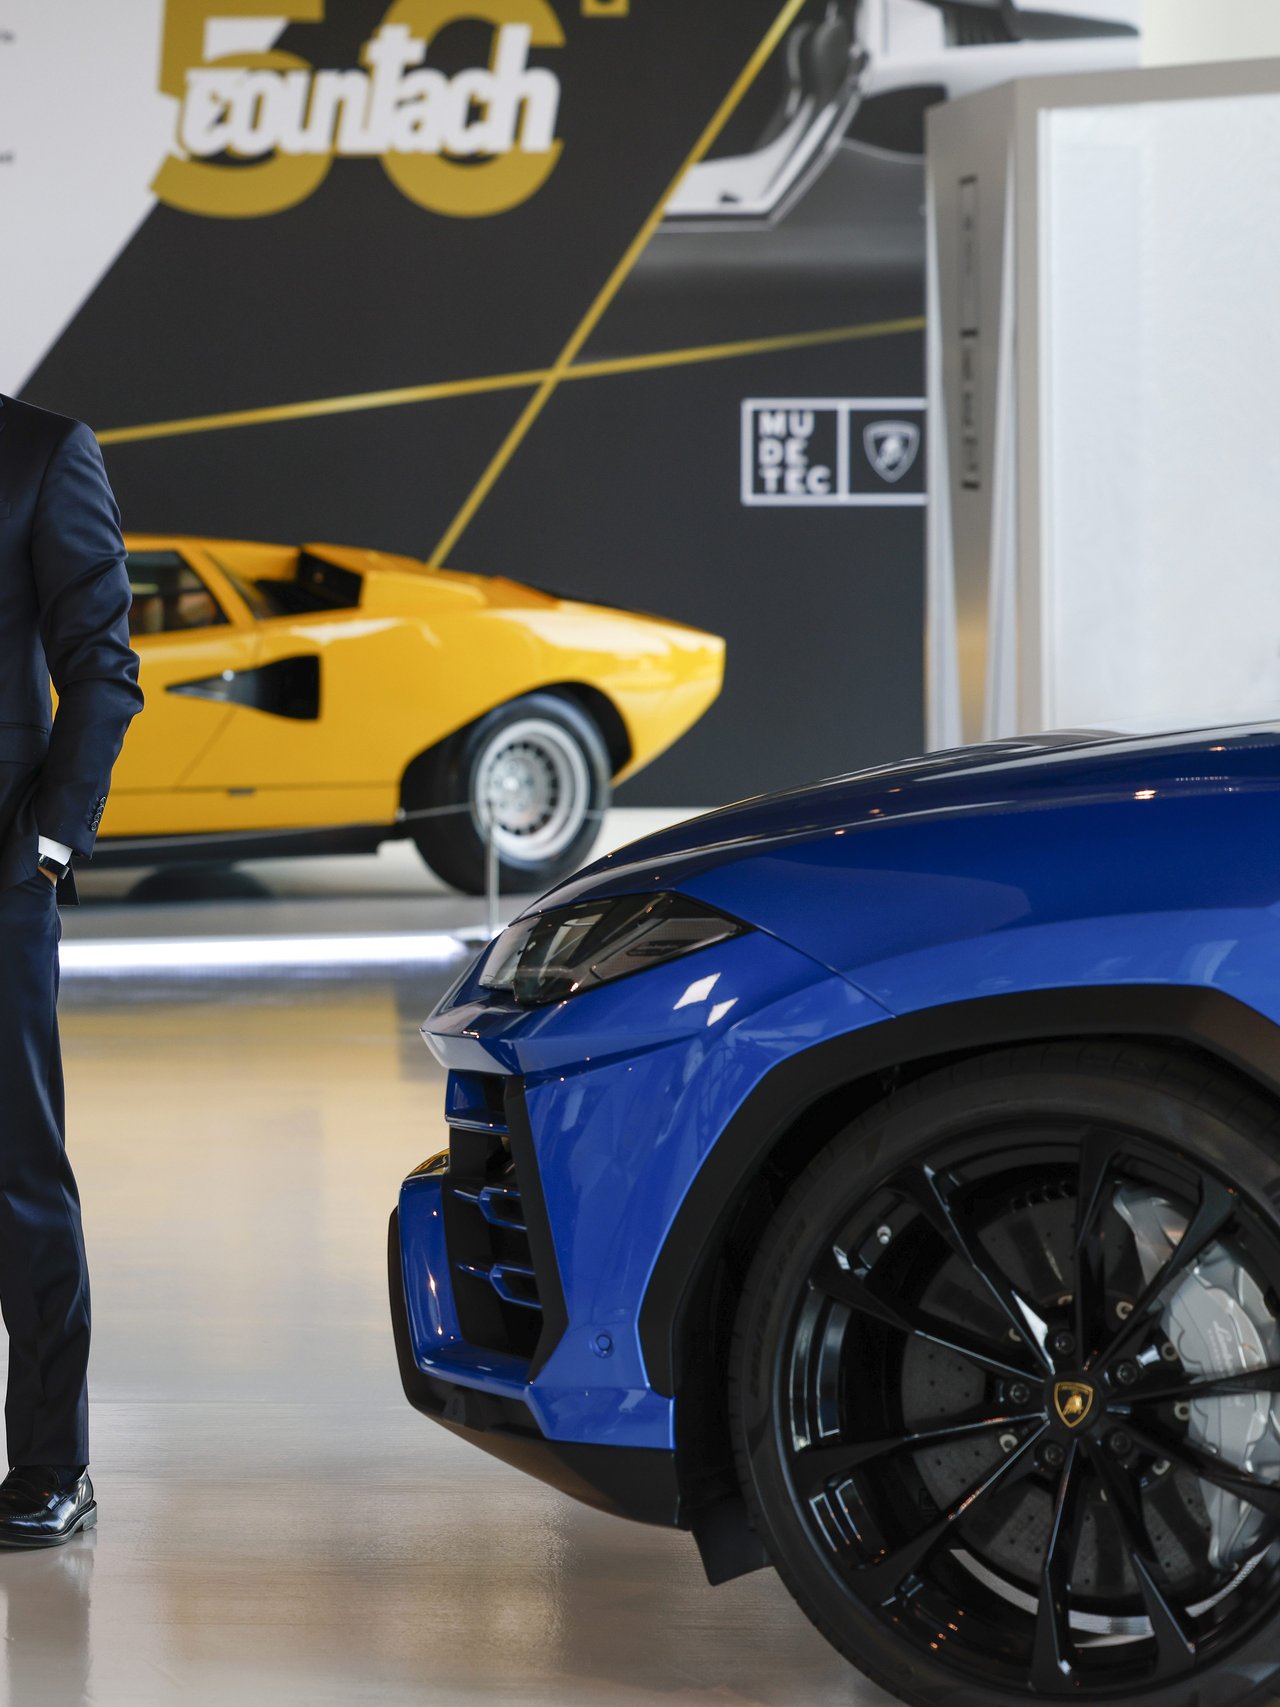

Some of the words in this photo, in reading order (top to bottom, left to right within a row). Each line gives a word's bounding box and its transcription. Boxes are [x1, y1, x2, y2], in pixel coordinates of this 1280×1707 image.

[758, 412, 815, 438] MU
[758, 439, 809, 467] DE
[757, 466, 832, 494] TEC
